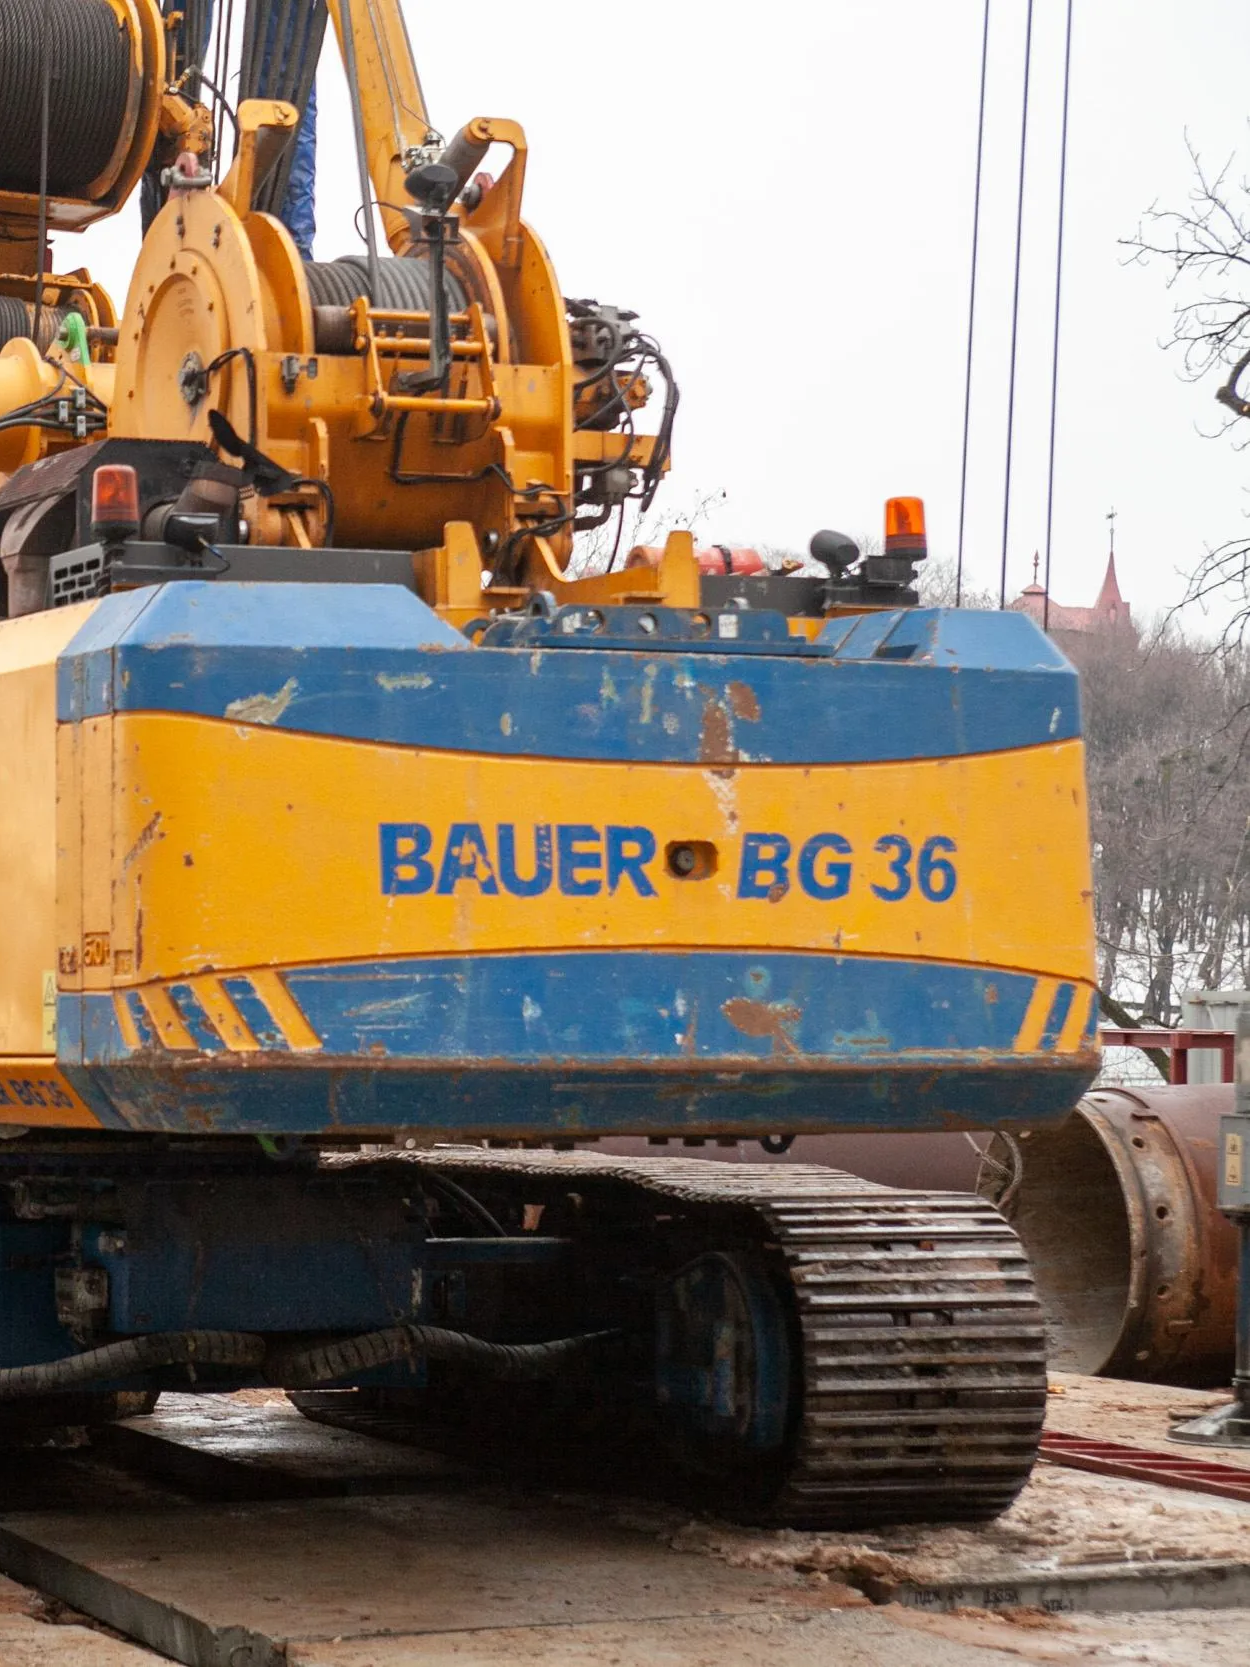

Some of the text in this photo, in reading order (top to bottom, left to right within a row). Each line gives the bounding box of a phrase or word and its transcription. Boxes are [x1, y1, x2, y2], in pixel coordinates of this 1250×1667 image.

[377, 822, 958, 904] BAUER BG 36
